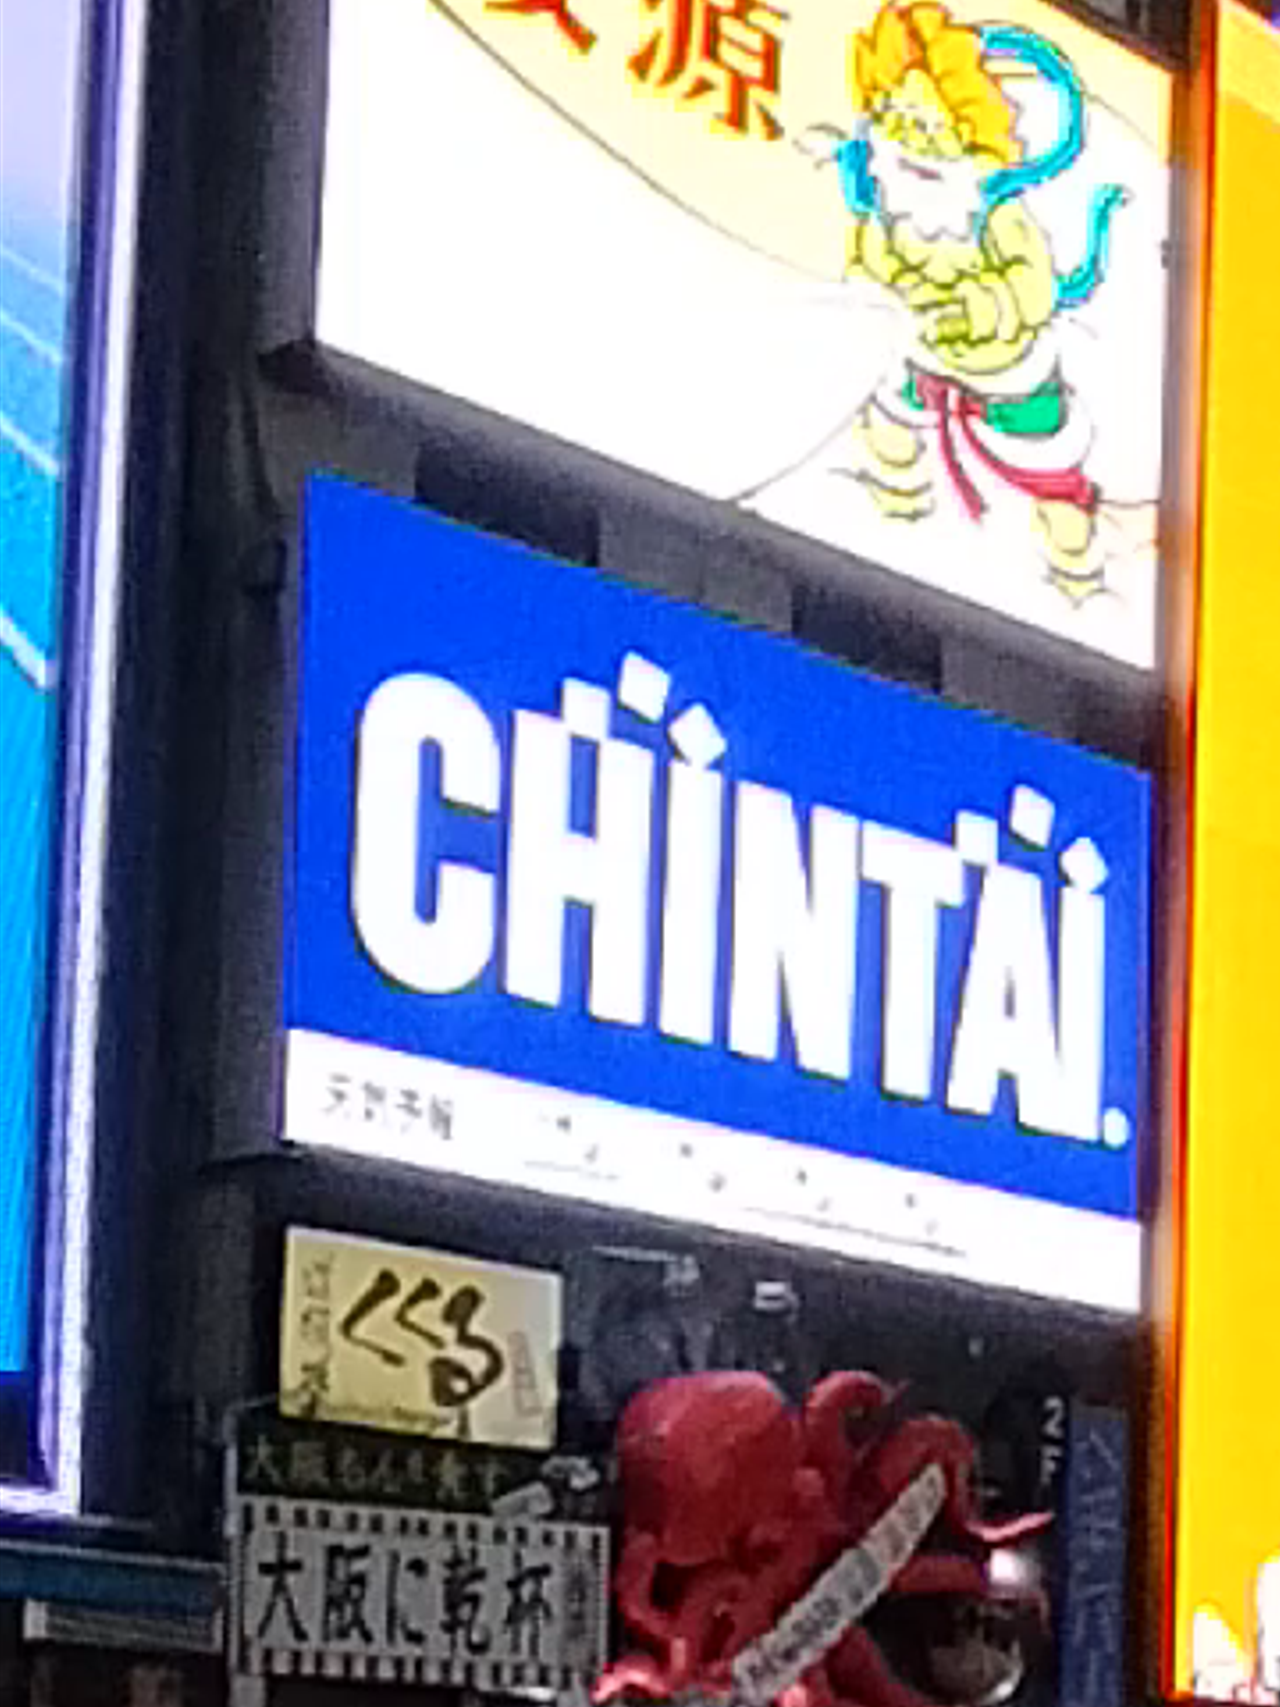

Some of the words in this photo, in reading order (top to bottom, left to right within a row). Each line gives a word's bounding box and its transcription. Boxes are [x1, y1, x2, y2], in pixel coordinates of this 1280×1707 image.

[337, 1267, 505, 1409] くくる
[257, 1529, 553, 1657] 大阪に乾杯
